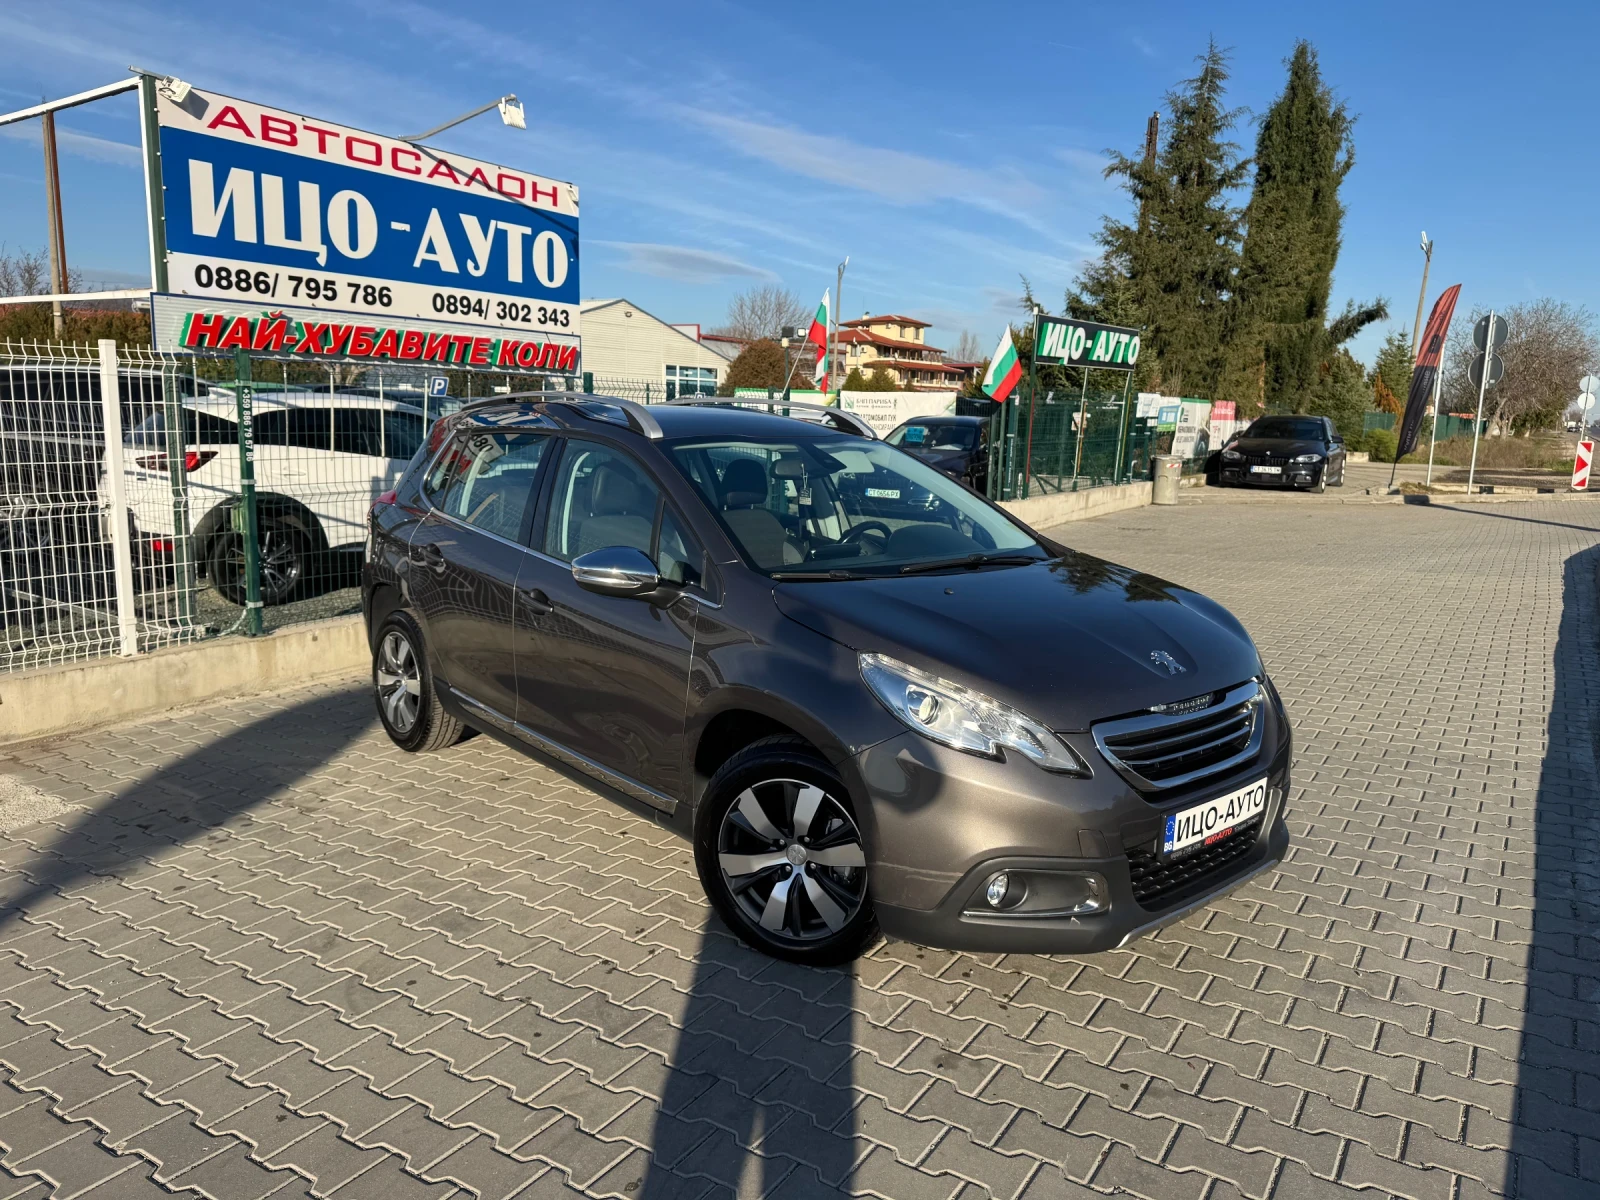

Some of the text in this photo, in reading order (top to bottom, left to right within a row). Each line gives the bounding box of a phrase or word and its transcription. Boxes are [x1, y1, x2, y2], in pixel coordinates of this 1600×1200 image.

[207, 105, 558, 207] АВТОСАЛОН
[194, 264, 393, 308] 0886/ 795 786
[432, 293, 570, 328] 0894/ 302 343
[180, 310, 578, 371] НАЙ-ХУБАВИТЕ КОЛИ
[1038, 322, 1141, 365] ИЦО-АУТО
[243, 388, 254, 462] +359 886 79 57 86
[1176, 785, 1264, 843] ИЦО-АУТО
[1163, 841, 1172, 852] BG
